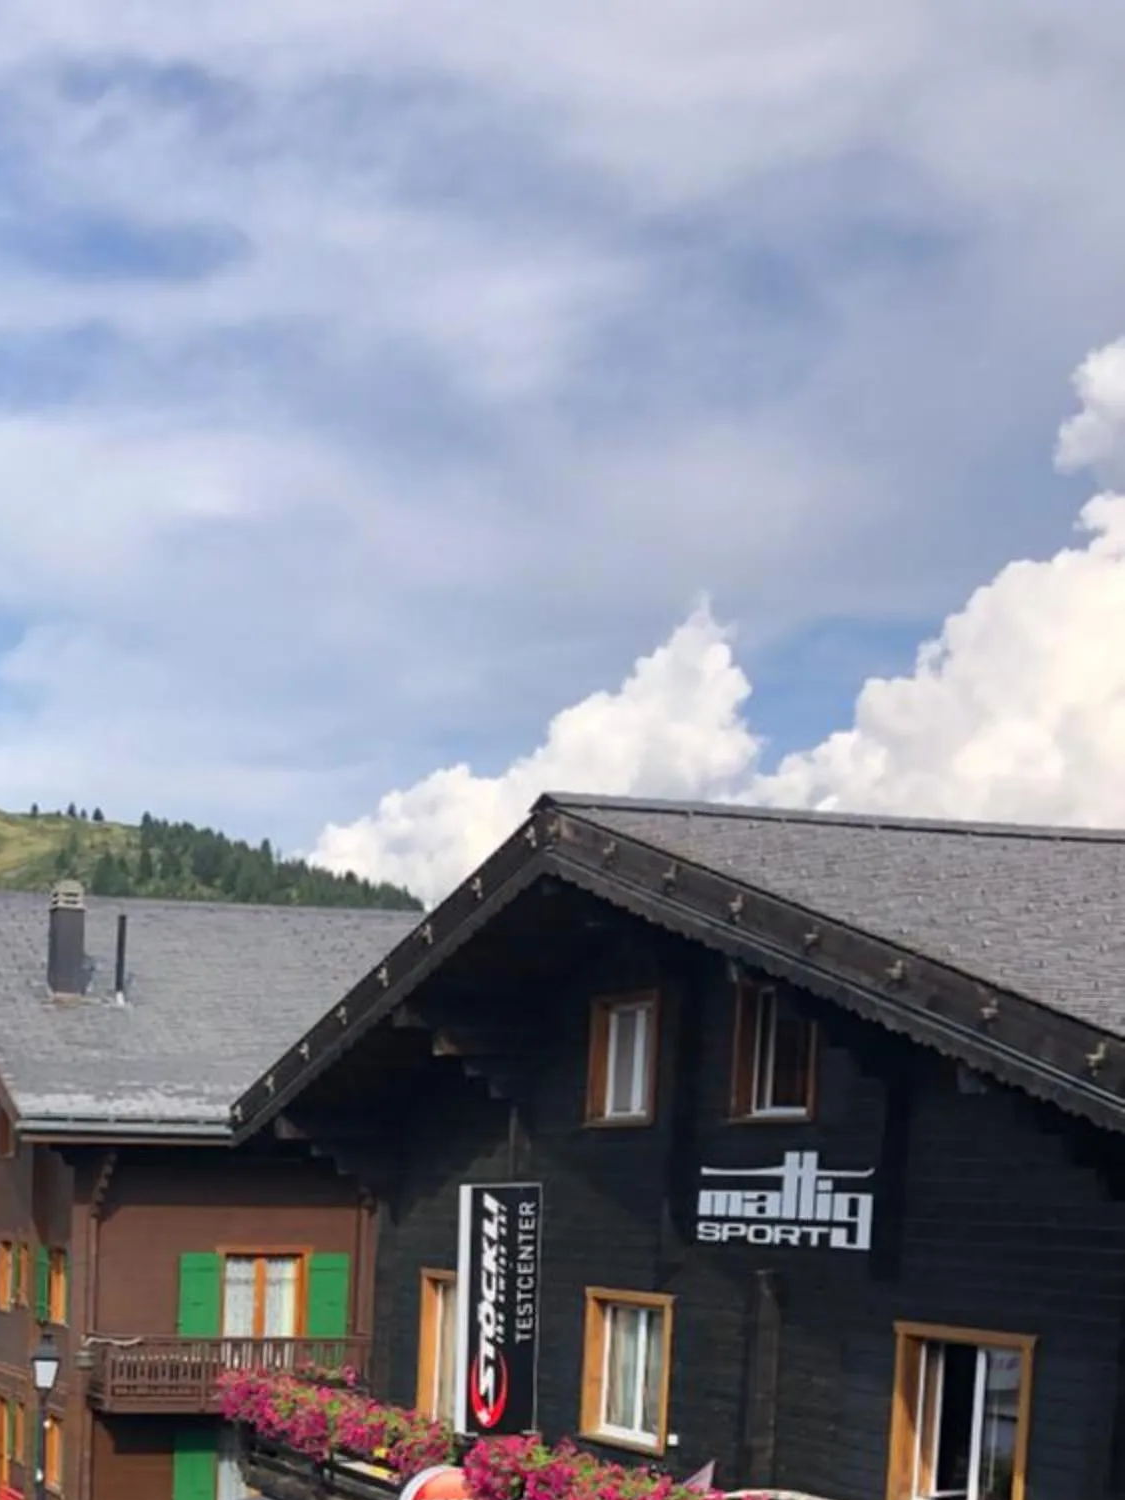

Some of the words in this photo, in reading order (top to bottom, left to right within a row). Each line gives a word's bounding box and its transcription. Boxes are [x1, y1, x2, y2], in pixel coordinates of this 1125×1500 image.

[696, 1221, 830, 1247] SPORT
[697, 1151, 874, 1250] mattig
[477, 1192, 503, 1411] STÖCKLI
[515, 1201, 537, 1344] TESTCENTER
